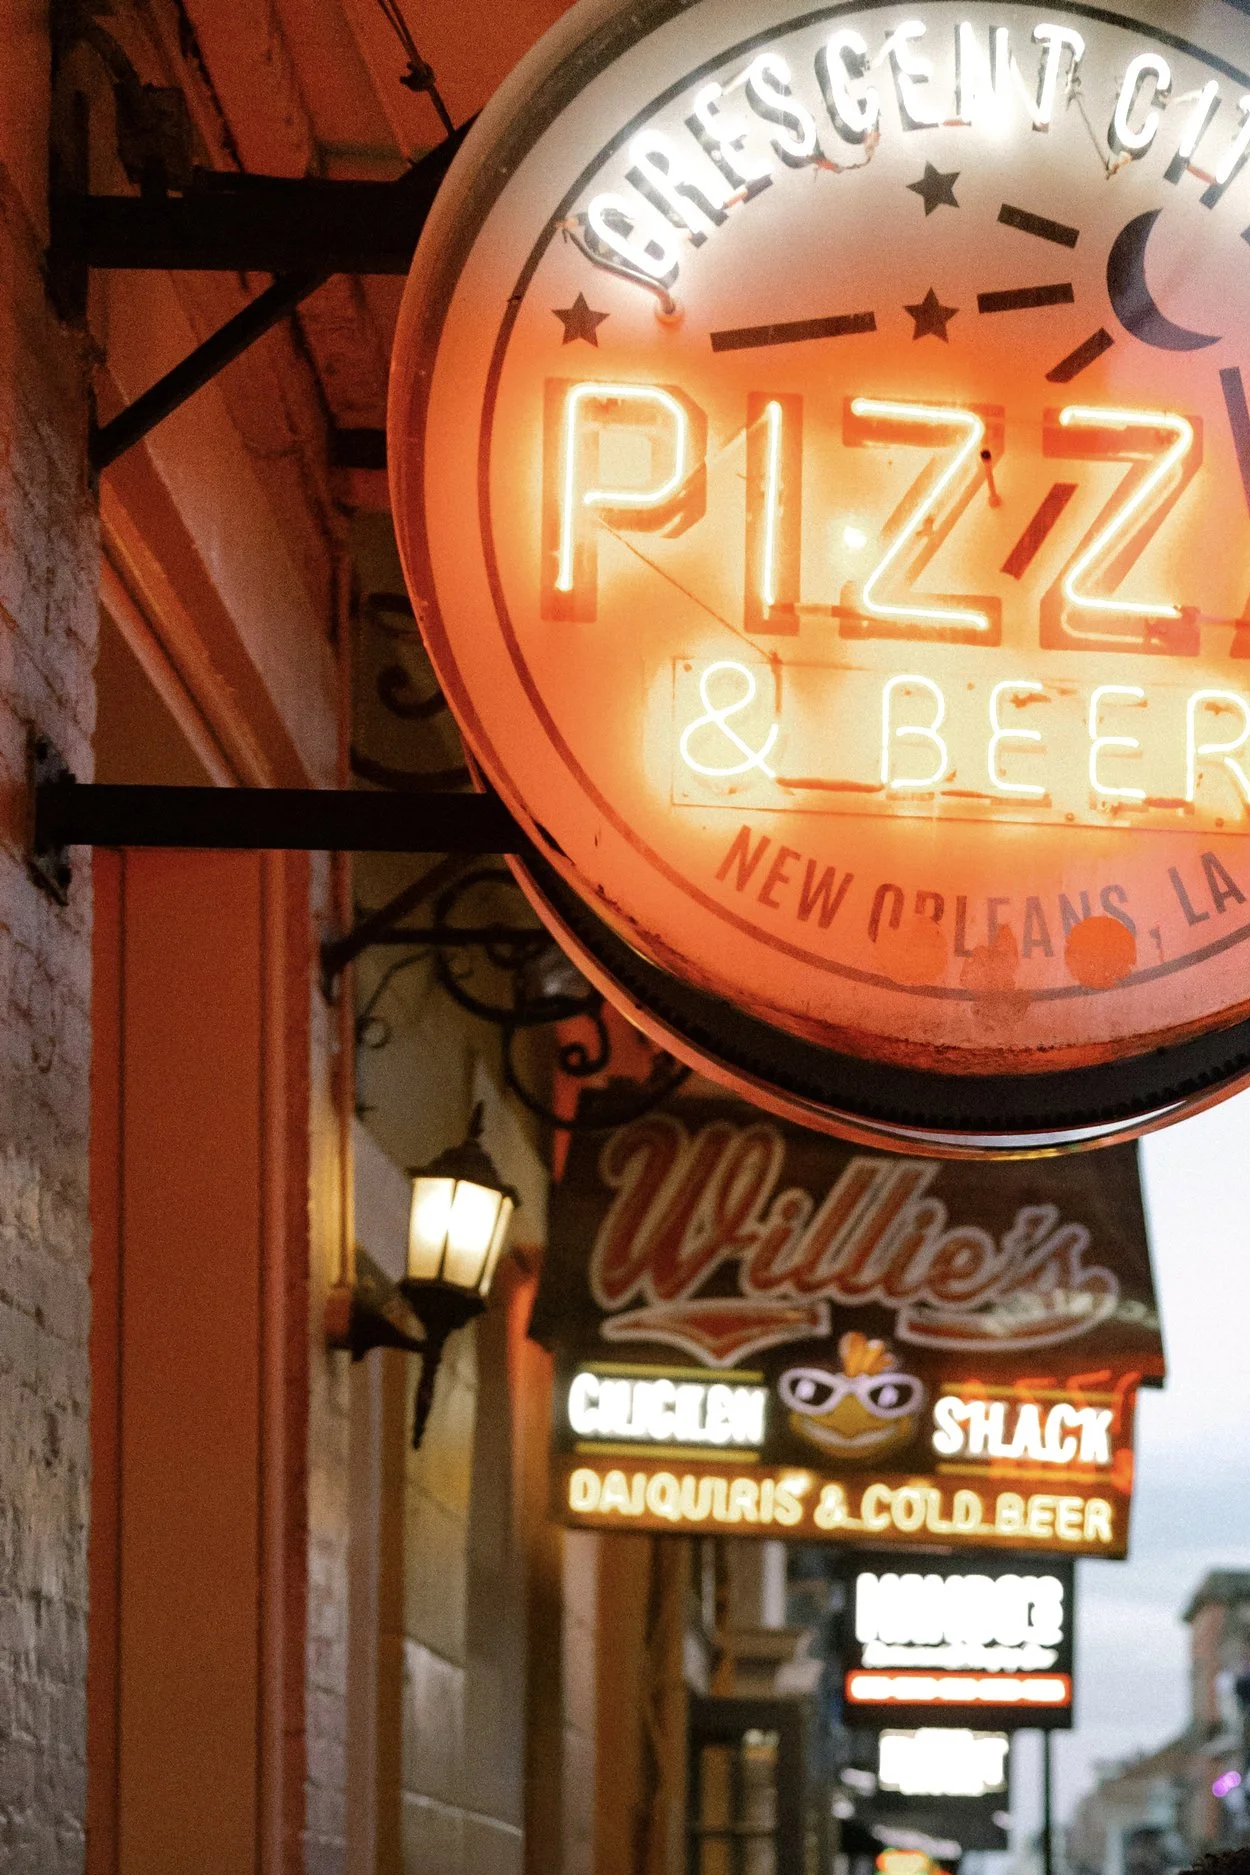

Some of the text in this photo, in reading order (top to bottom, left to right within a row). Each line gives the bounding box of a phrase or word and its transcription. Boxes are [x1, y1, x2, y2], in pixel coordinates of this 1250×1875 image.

[583, 18, 1086, 290] CRESCENT
[678, 660, 780, 780] &
[716, 823, 856, 931] NEW
[1167, 850, 1248, 927] LA
[589, 1111, 1119, 1325] Willie's
[932, 1395, 1114, 1464] SHACK
[569, 1467, 1113, 1543] DAIQUIRIS & COLD BEER
